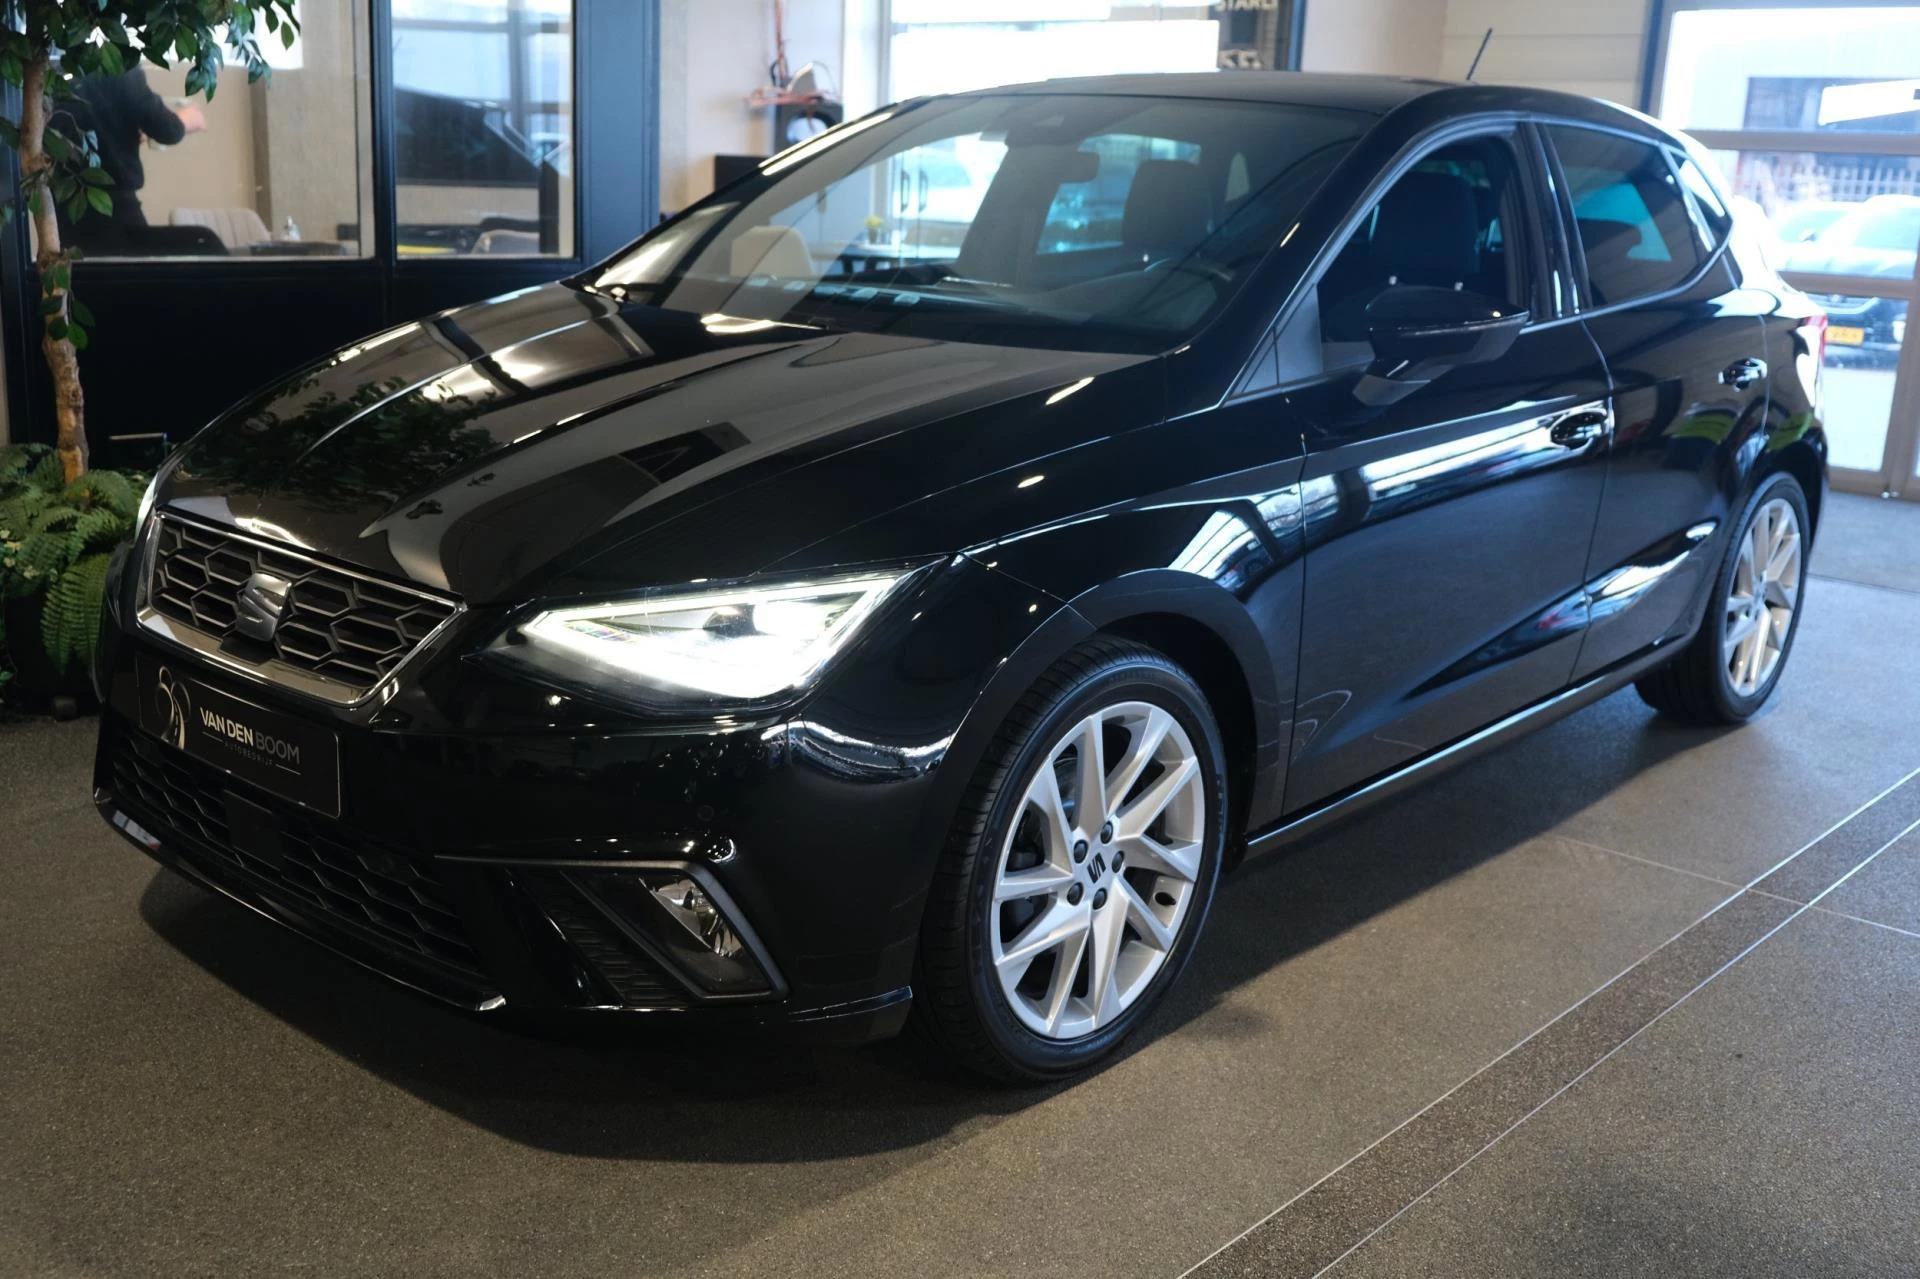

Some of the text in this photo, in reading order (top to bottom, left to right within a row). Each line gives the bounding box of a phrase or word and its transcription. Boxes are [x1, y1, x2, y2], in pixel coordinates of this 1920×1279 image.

[200, 707, 300, 764] VAN DEN BOOM
